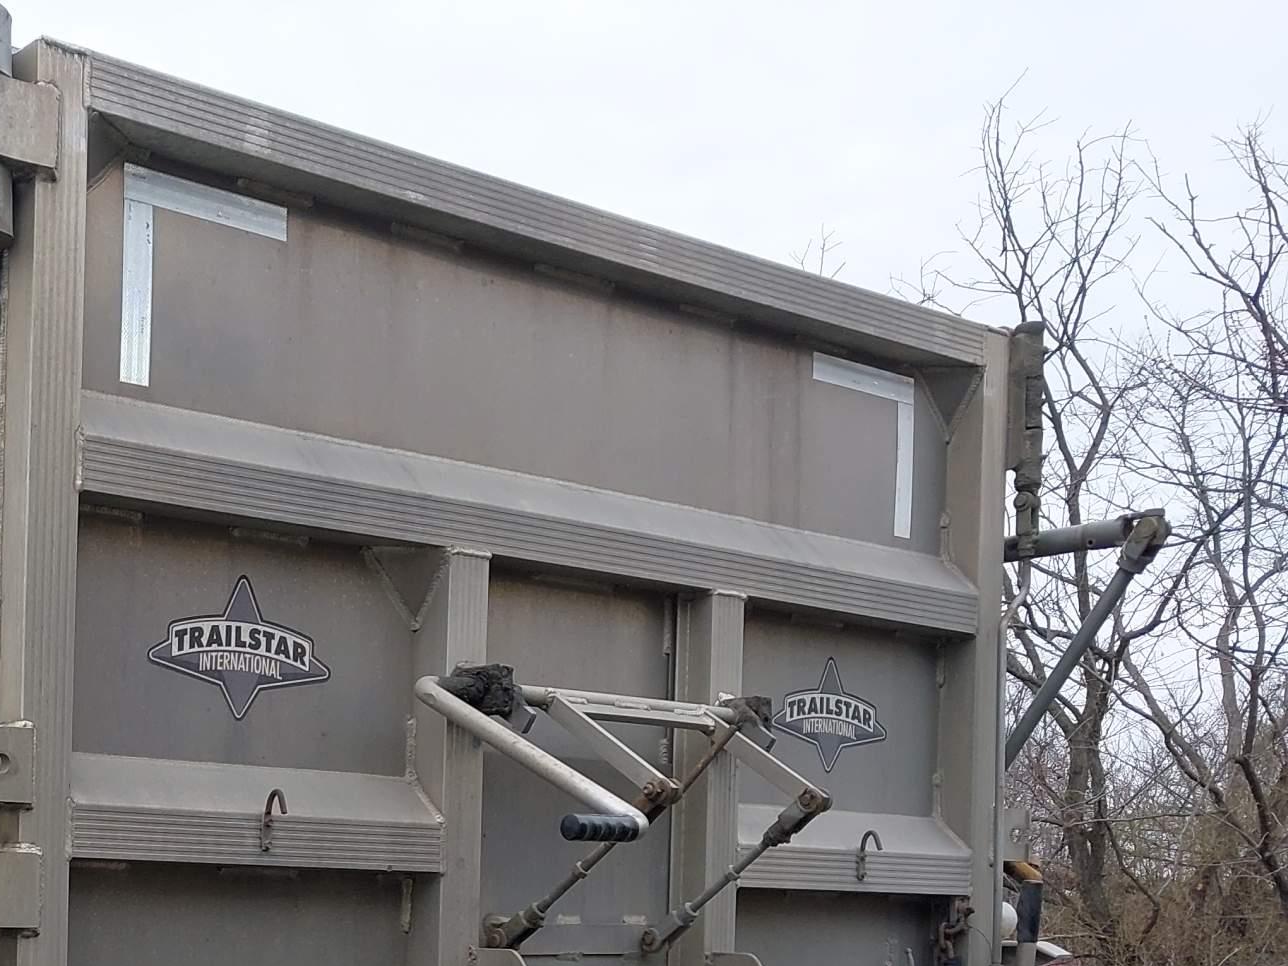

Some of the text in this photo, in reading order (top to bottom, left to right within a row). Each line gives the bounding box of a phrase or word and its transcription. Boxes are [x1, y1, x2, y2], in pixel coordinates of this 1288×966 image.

[174, 624, 309, 667] TRAILSTAR
[199, 653, 282, 680] INTERNATIONAL
[787, 696, 873, 729] TRAILSTAR
[802, 718, 857, 740] INTERNATIONAL
